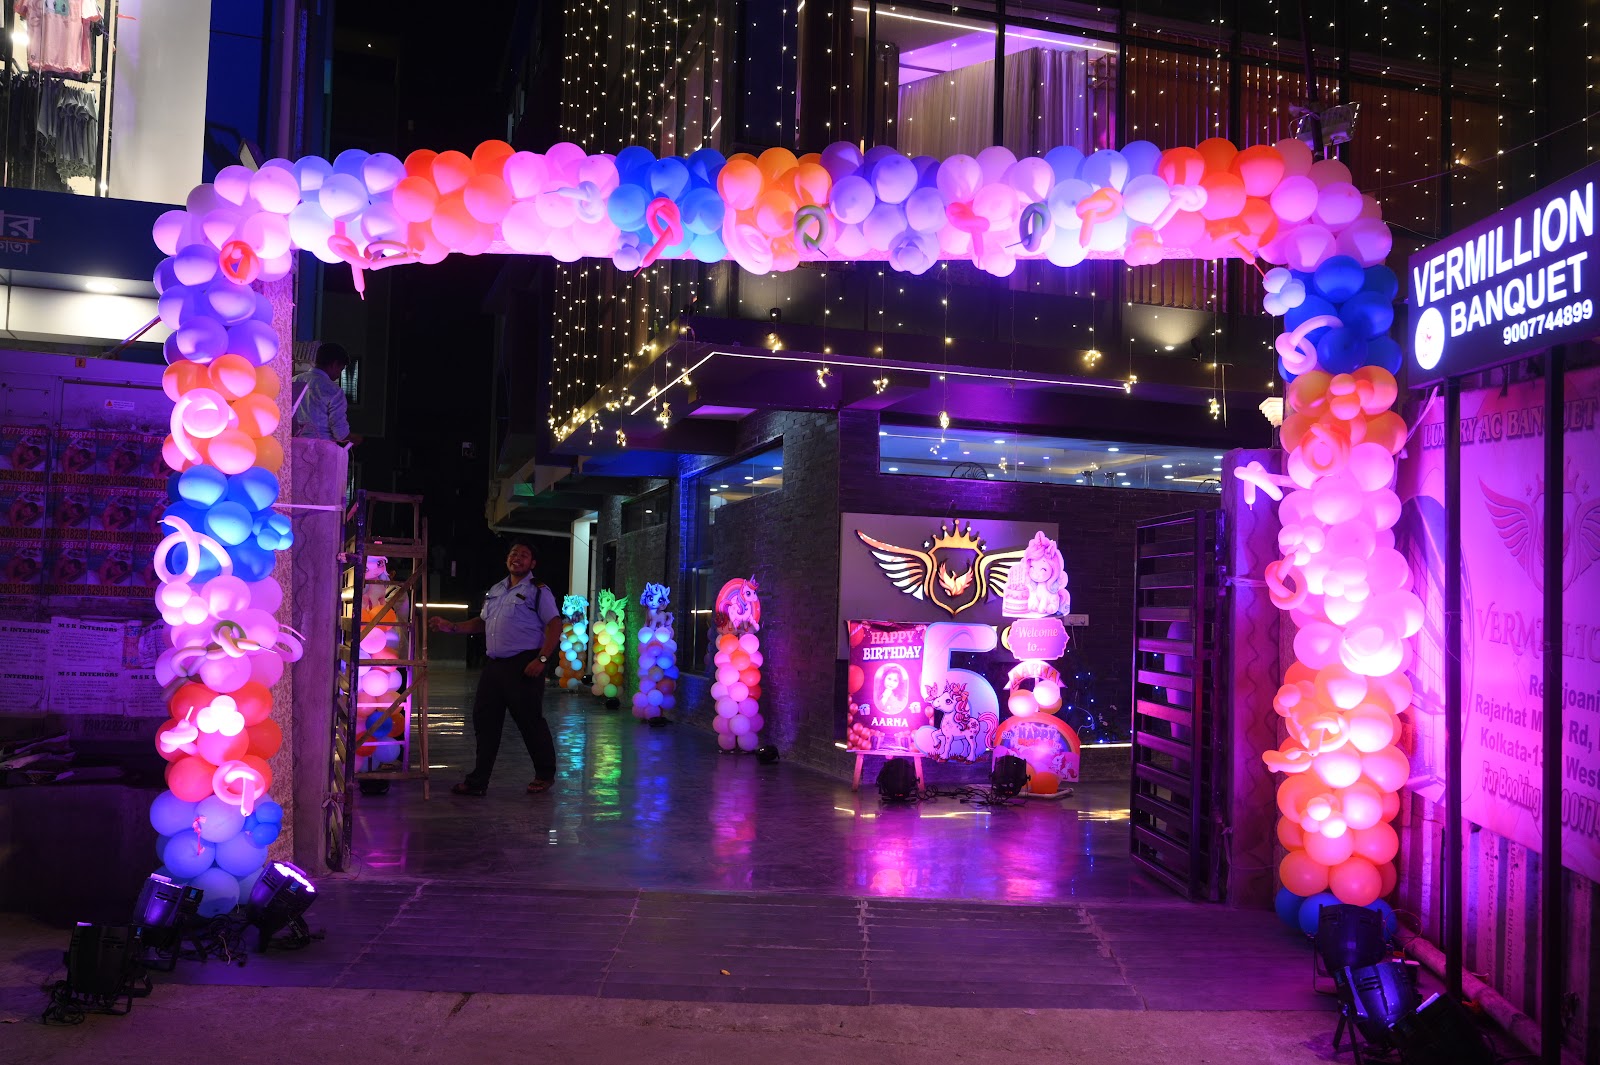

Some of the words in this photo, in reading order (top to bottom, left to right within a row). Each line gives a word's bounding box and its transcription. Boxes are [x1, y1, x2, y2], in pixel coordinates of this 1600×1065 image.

[1413, 181, 1594, 308] VERMILLION
[1450, 251, 1588, 338] BANQUET
[1502, 298, 1593, 346] 9007744899
[1423, 417, 1478, 449] LUXRY
[1479, 413, 1502, 442] AC
[141, 479, 167, 490] 629031
[132, 587, 154, 597] 62903
[10, 626, 50, 635] INTERIORS
[79, 624, 118, 633] INTERIORS
[1016, 625, 1059, 639] Welcome
[870, 630, 915, 645] HAPPY
[862, 646, 922, 662] BIRTHDAY
[4, 673, 44, 681] INTERIORS
[1475, 693, 1528, 727] Rajarhat
[1482, 760, 1499, 794] For
[1500, 767, 1541, 817] Booking
